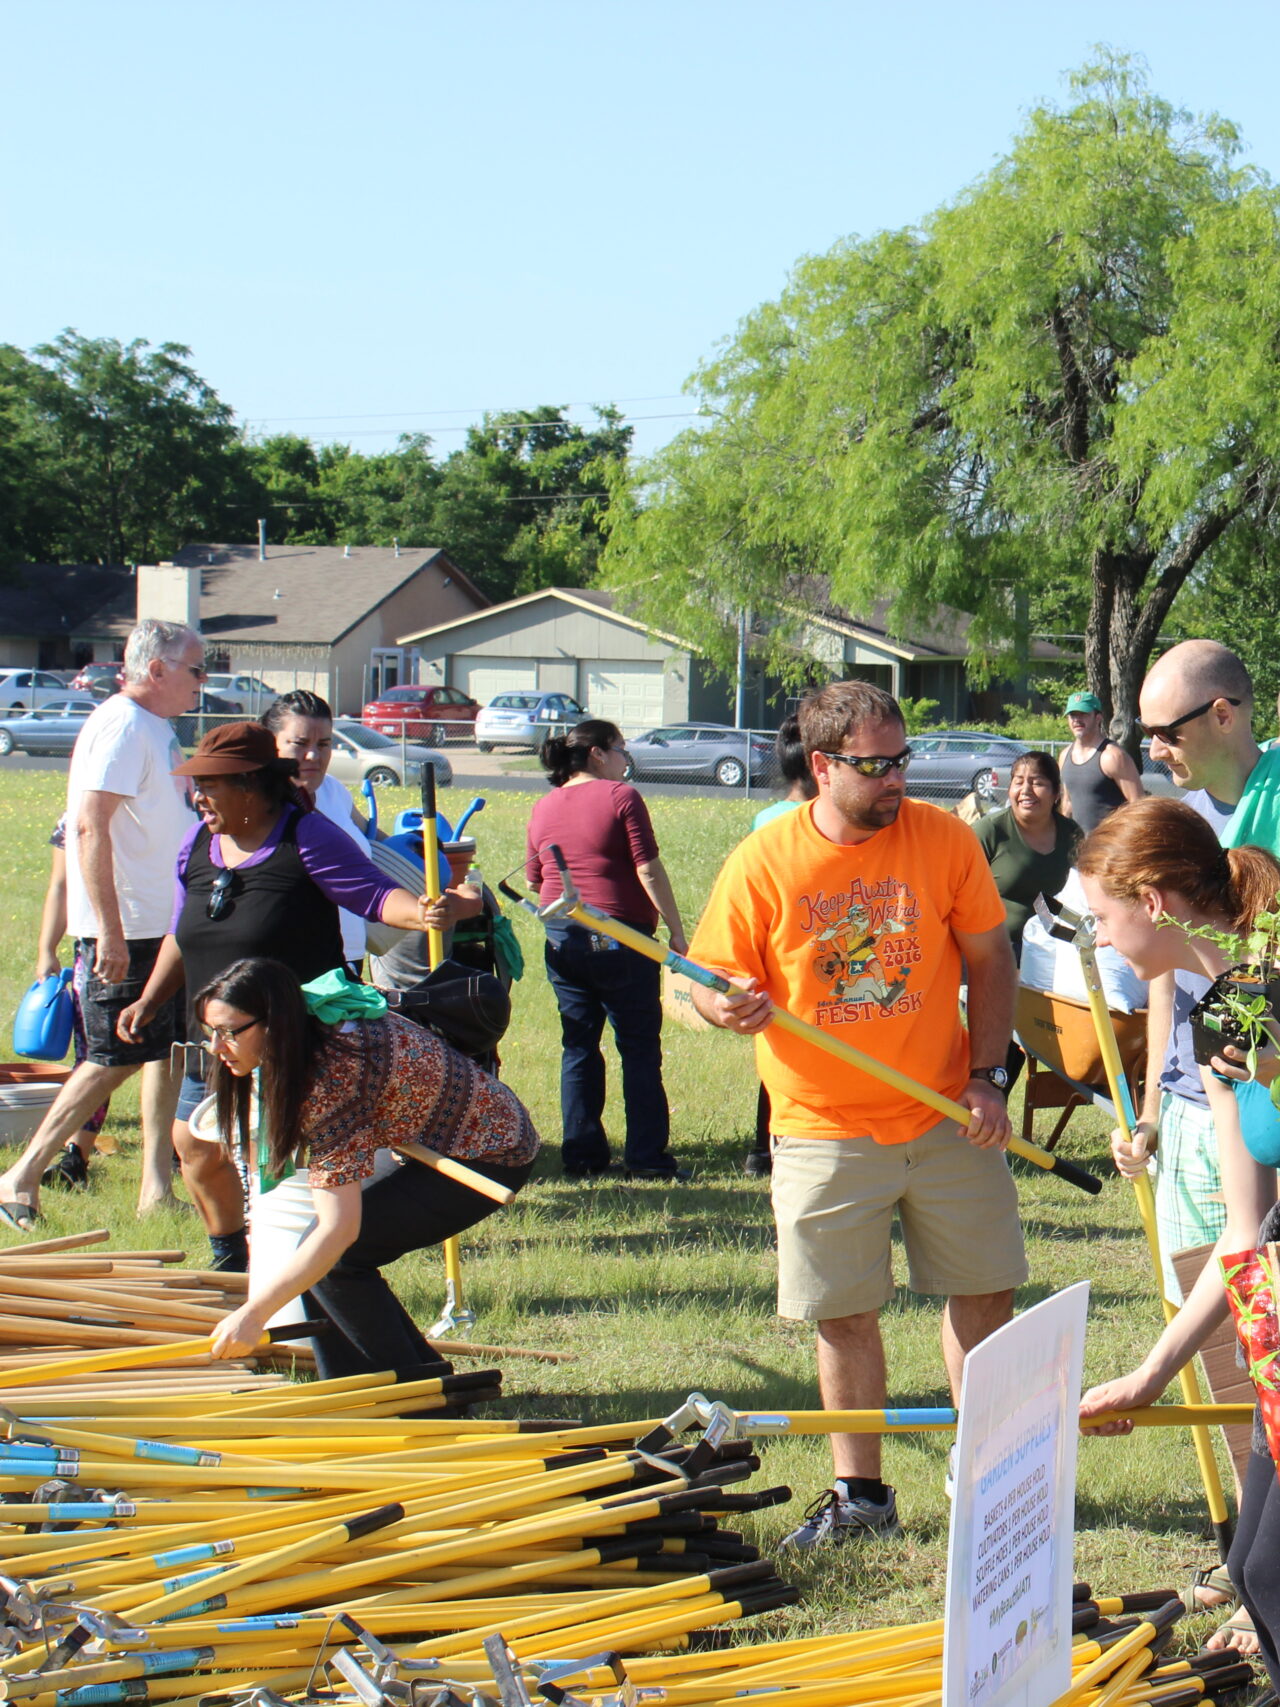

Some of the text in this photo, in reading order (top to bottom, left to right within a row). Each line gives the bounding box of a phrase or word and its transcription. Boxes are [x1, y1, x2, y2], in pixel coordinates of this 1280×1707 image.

[800, 876, 913, 931] Keep Austin
[867, 899, 920, 929] Weird
[883, 937, 920, 954] ATX
[884, 951, 922, 967] 2016
[815, 992, 923, 1026] FEST & 5K
[980, 1411, 1050, 1495] GARDEN SUPPLIES
[978, 1518, 1007, 1560] CULTIVATORS
[1011, 1507, 1020, 1529] PER
[1020, 1492, 1036, 1520] HOUSE
[1036, 1482, 1048, 1506] HOLD
[983, 1498, 1004, 1531] BASKETS
[1007, 1488, 1016, 1509] PER
[1016, 1474, 1032, 1501] HOUSE
[1032, 1463, 1045, 1486] HOLD
[972, 1574, 998, 1614] WATERING
[997, 1562, 1010, 1588] CANS
[1013, 1549, 1022, 1573] PER
[1022, 1535, 1038, 1564] HOUSE
[1038, 1523, 1051, 1548] HOLD
[976, 1552, 996, 1587] SCUFFLE
[995, 1541, 1008, 1567] HOES
[1012, 1529, 1021, 1552] PER
[1021, 1514, 1036, 1544] HOUSE
[1036, 1503, 1049, 1528] HOLD
